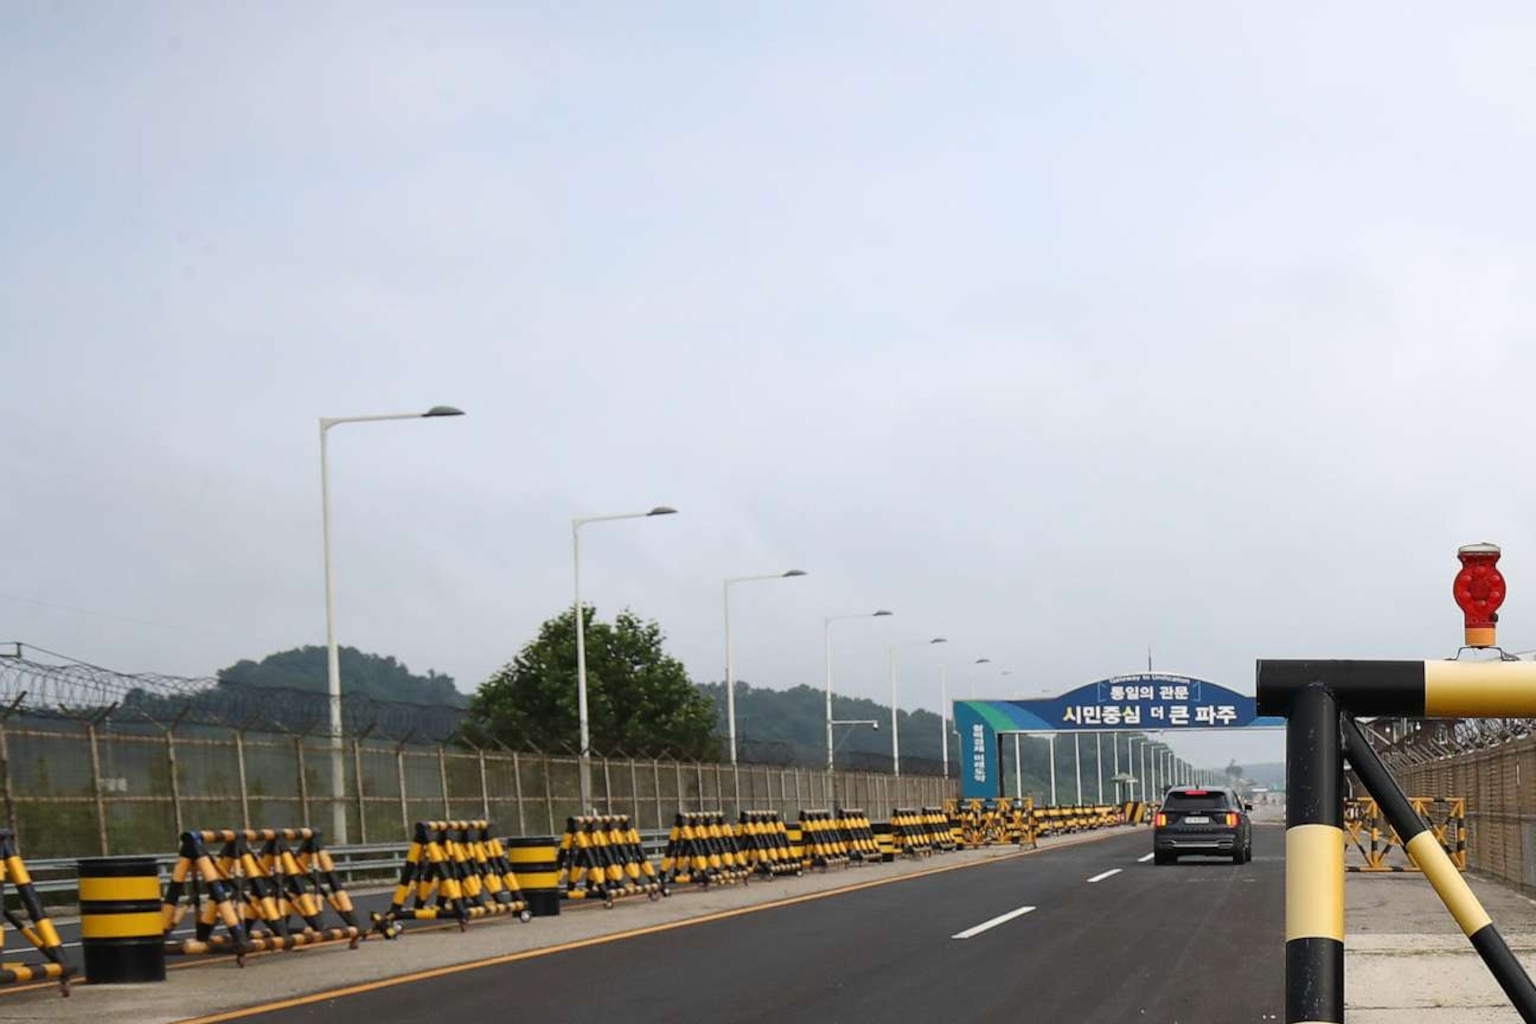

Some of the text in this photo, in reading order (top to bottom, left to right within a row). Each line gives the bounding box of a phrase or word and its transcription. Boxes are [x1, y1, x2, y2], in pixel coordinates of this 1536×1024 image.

[1109, 686, 1189, 700] 통일의 관문
[1063, 705, 1237, 725] 시민중심 더 큰 파주
